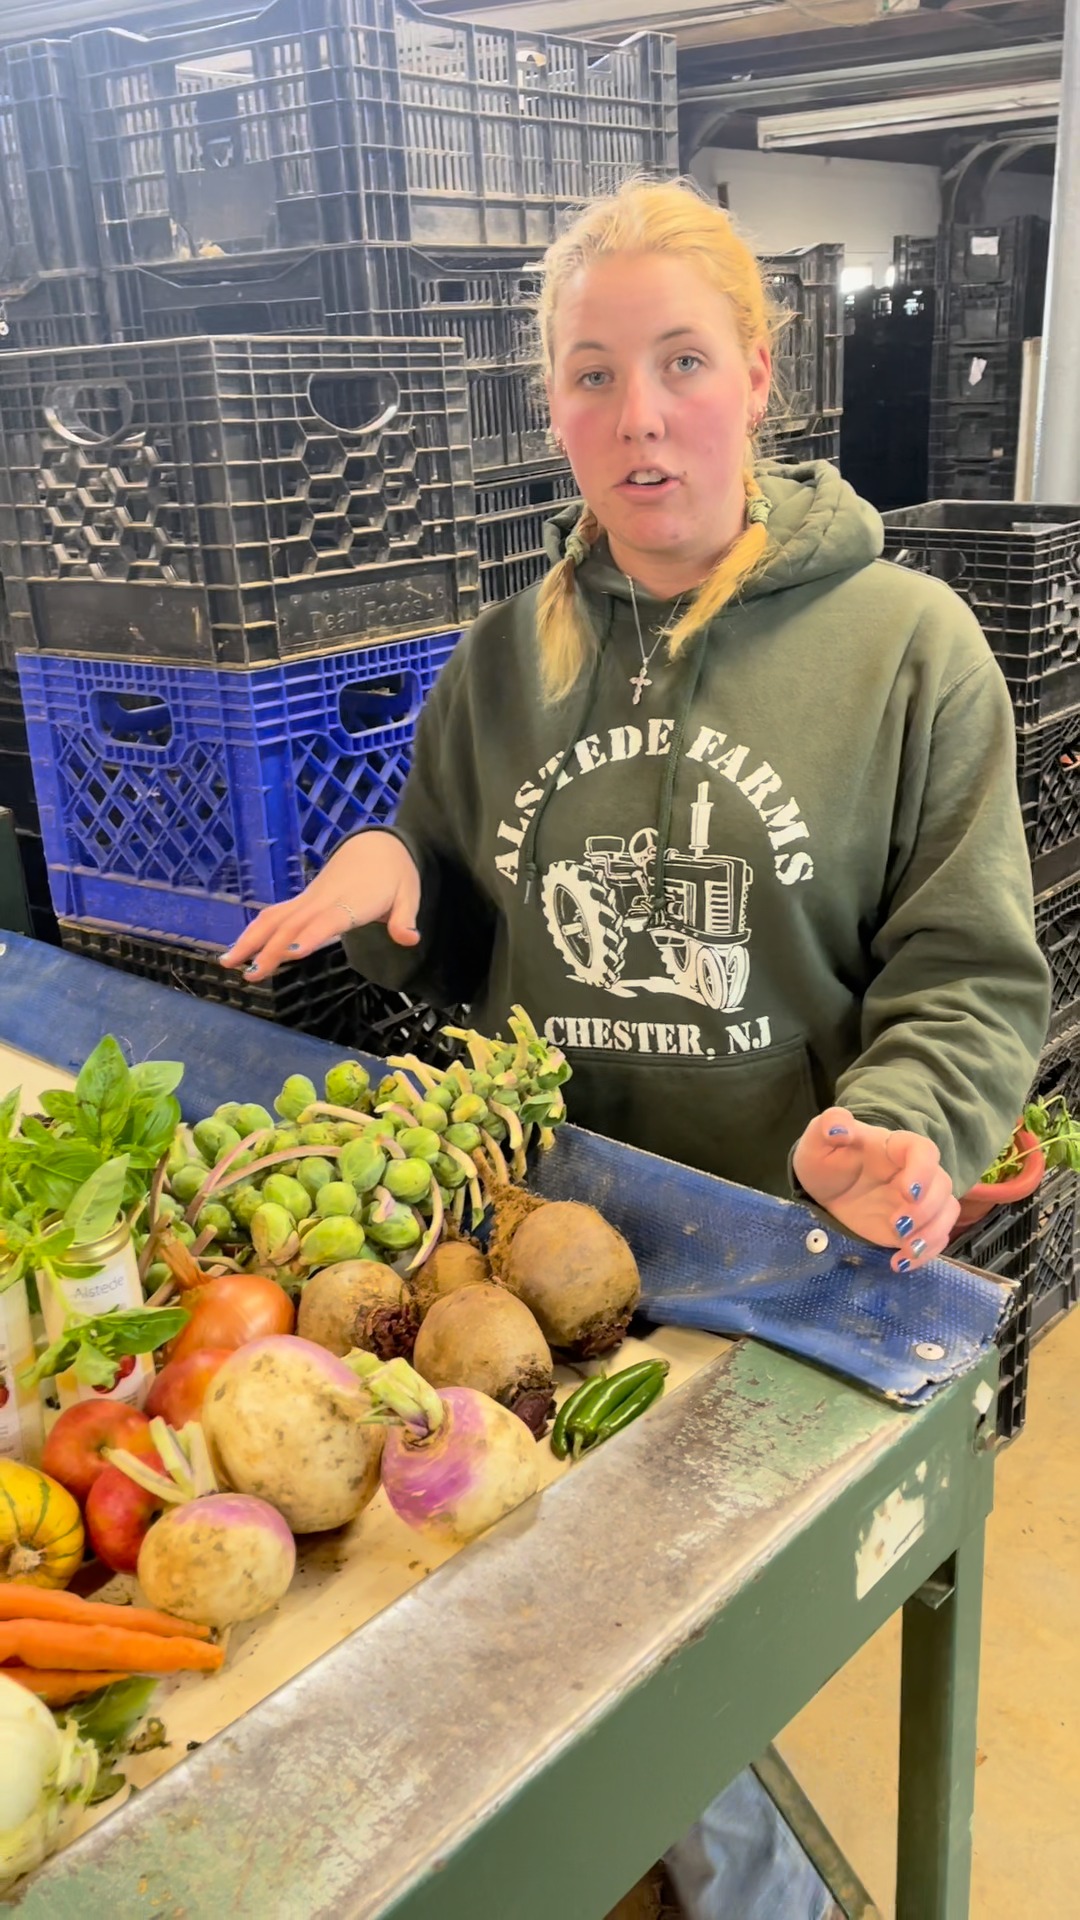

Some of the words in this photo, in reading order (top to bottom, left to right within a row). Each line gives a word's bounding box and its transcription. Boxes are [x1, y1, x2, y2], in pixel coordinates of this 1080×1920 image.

[494, 718, 675, 886] ALSTEDE
[686, 726, 815, 886] FARMS
[724, 1015, 772, 1056] NJ
[74, 1276, 125, 1298] Alstede
